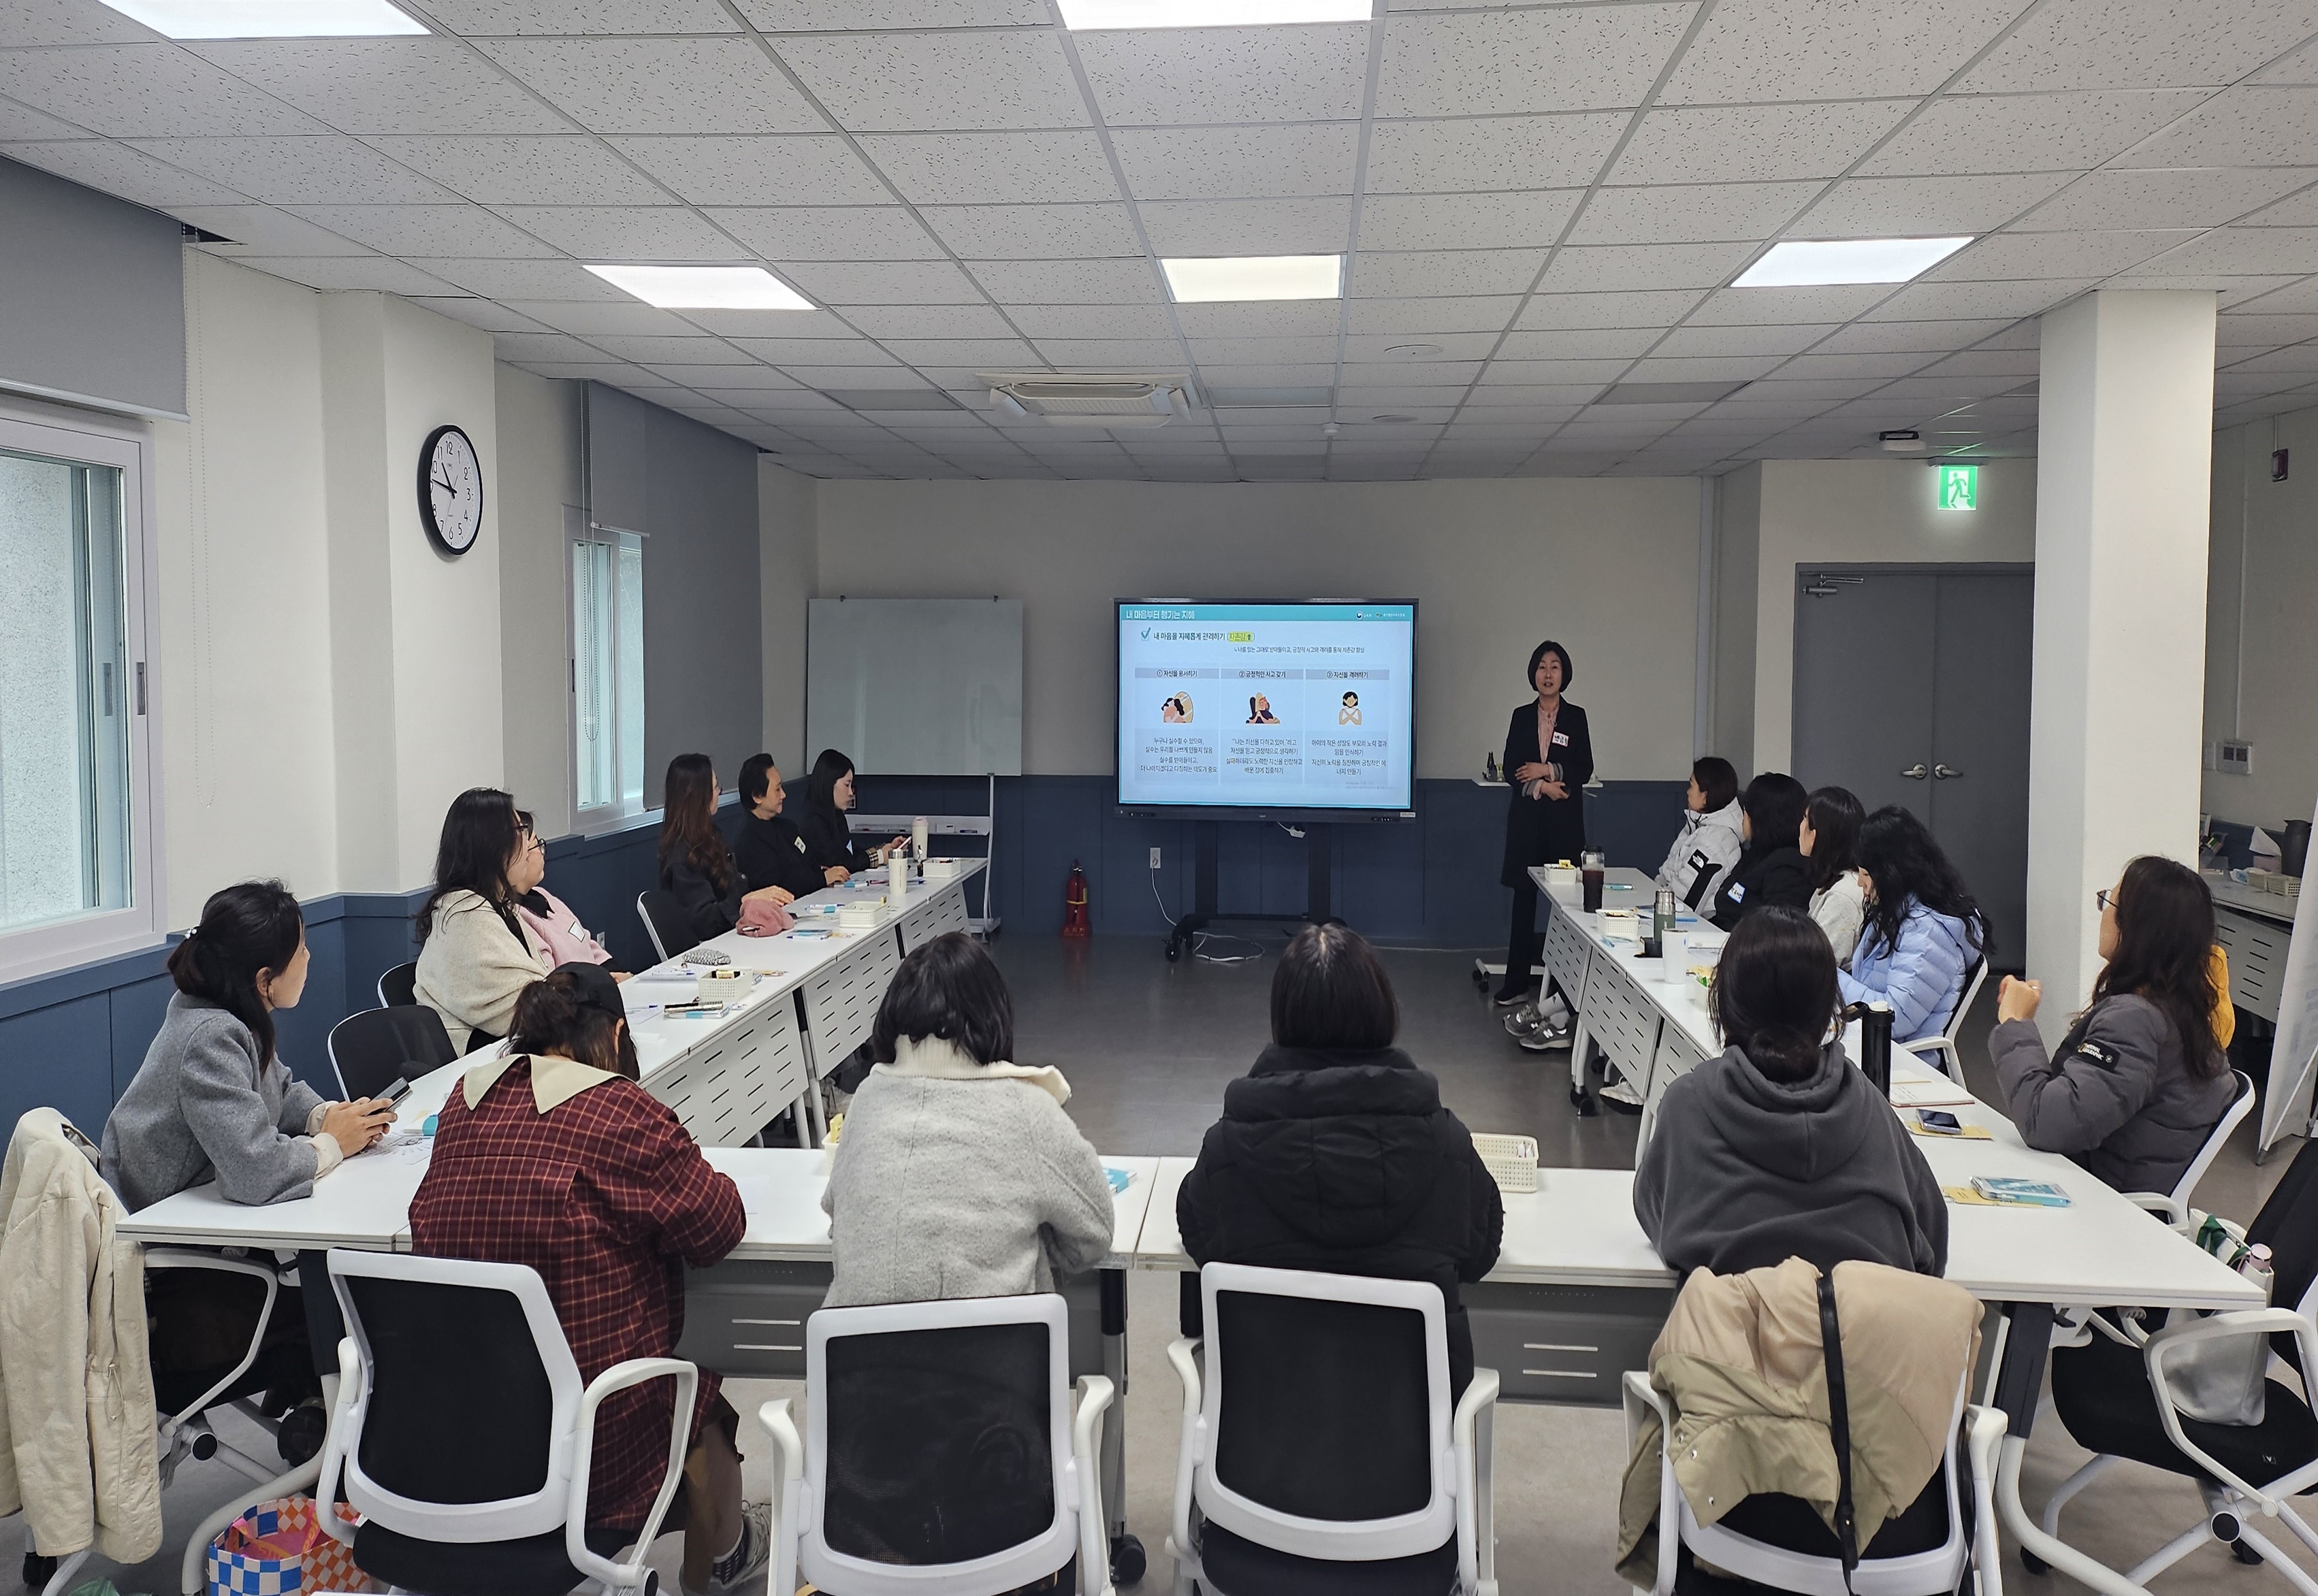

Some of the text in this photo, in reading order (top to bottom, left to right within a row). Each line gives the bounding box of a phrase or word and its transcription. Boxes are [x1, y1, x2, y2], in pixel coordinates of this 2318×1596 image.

[437, 446, 443, 459] 11
[445, 441, 453, 455] 12
[457, 451, 461, 463] 1
[464, 467, 468, 480] 2
[466, 488, 471, 500] 3
[464, 510, 468, 522] 4
[440, 520, 444, 532] 7
[457, 523, 462, 535] 5
[449, 527, 454, 540] 6
[1126, 610, 1195, 619] 내 마음부터 챙기는 지혜
